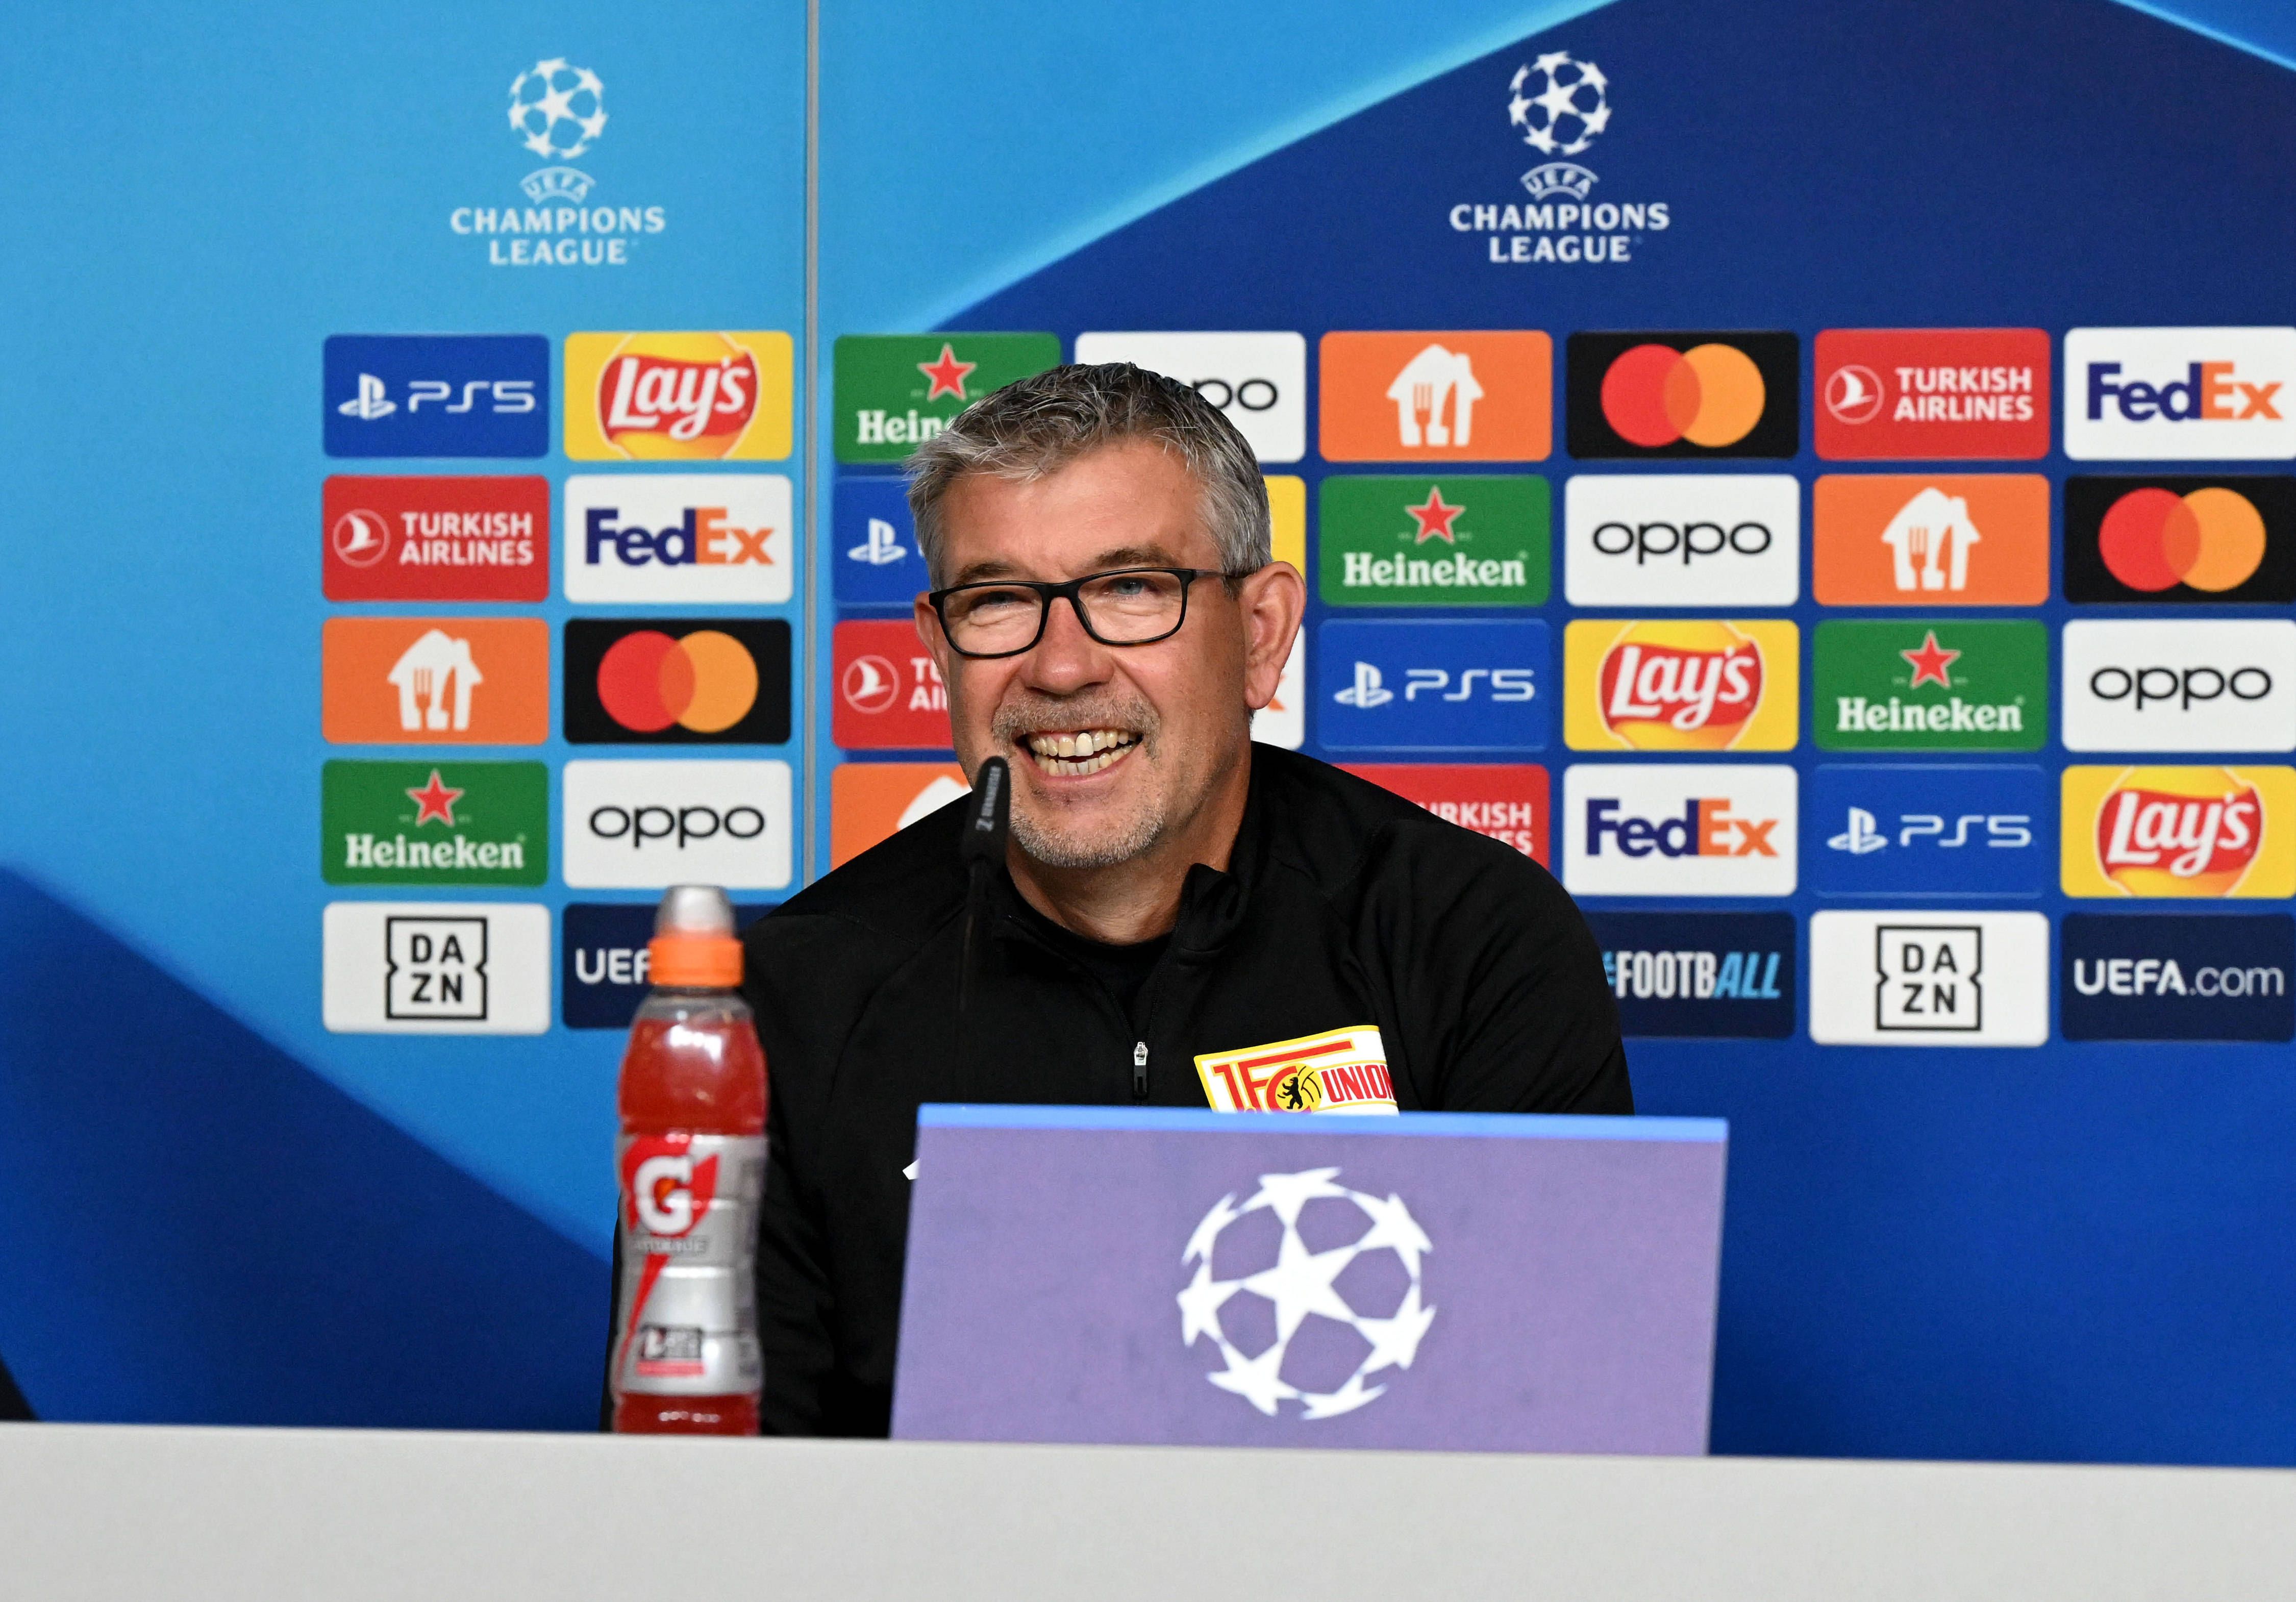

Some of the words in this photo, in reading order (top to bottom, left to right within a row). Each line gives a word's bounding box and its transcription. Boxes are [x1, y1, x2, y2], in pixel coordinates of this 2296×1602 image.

[523, 172, 590, 199] UEFA
[1524, 169, 1592, 195] UEFA
[451, 206, 665, 234] CHAMPIONS
[1450, 203, 1669, 231] CHAMPIONS
[490, 239, 626, 264] LEAGUE
[1490, 236, 1630, 262] LEAGUE
[1896, 367, 2031, 392] TURKISH
[2087, 362, 2283, 421] FedEx
[409, 381, 535, 412] PS5
[609, 357, 748, 439] Lay's
[1894, 395, 2033, 421] AIRLINES
[858, 410, 952, 443] Hein
[402, 513, 532, 537] TURKISH
[586, 508, 773, 566] FedEx
[400, 540, 533, 565] AIRLINES
[1593, 522, 1771, 565] oppo
[1344, 553, 1525, 586] Heineken
[1406, 669, 1535, 700] PS5
[1610, 645, 1755, 730] Lay's
[2090, 667, 2272, 711] oppo
[1838, 697, 2022, 731] Heineken
[589, 807, 764, 848] oppo
[1586, 798, 1778, 858] FedEx
[1900, 815, 2031, 847] PS5
[2108, 793, 2253, 876] Lay's
[346, 834, 523, 868] Heineken
[2075, 959, 2283, 996] UEFA.com
[634, 1155, 693, 1235] G
